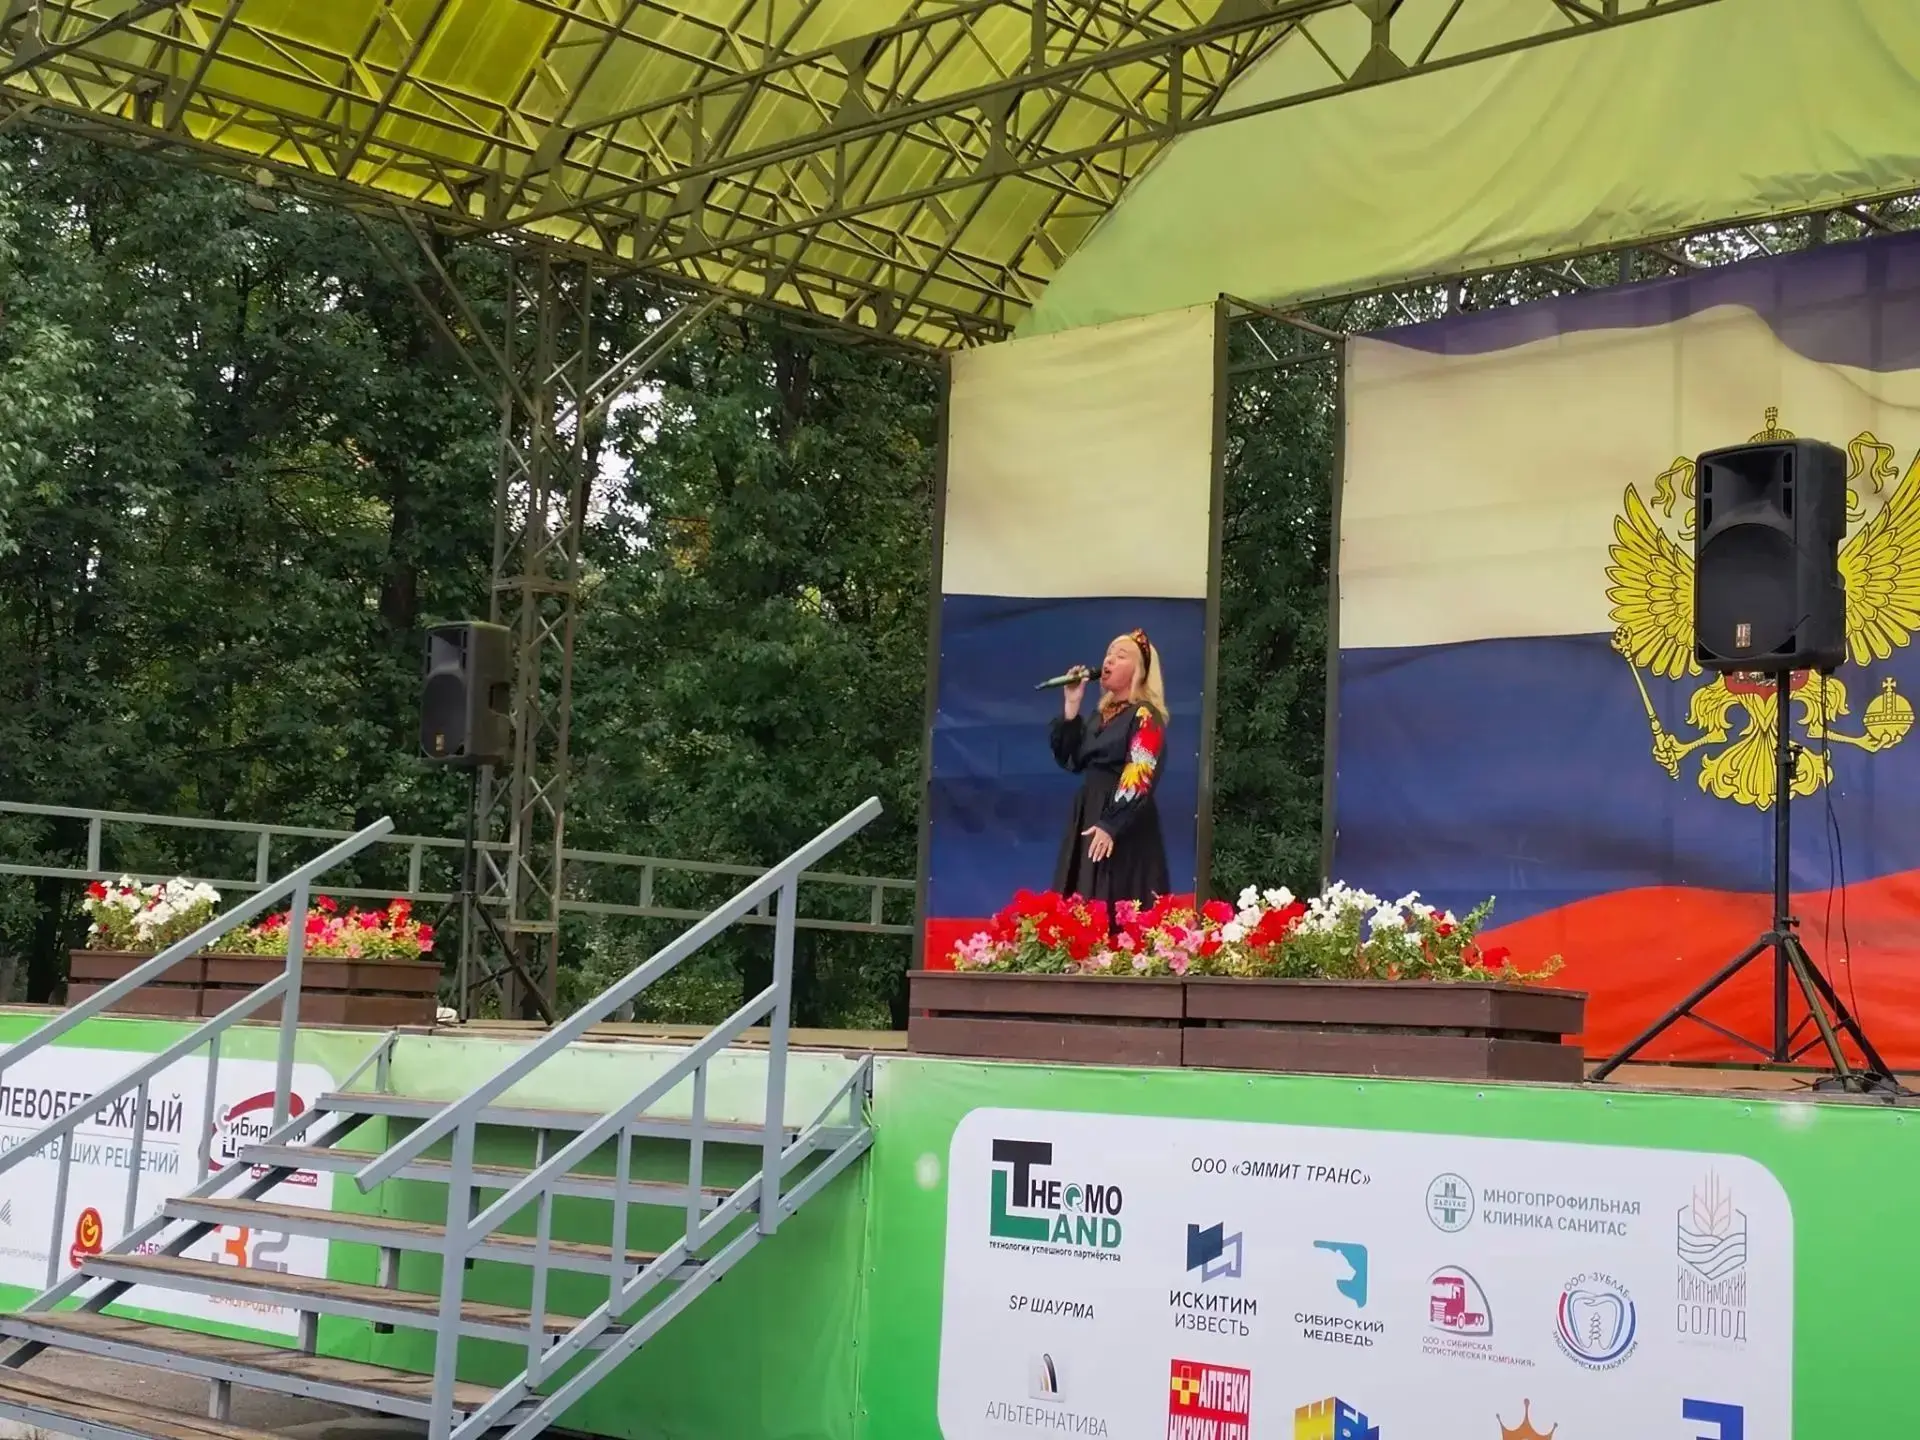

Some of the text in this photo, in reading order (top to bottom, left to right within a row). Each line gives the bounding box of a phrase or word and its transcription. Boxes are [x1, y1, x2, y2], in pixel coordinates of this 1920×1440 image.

[1191, 1156, 1372, 1186] ООО «ЭММИТ ТРАНС»
[1483, 1188, 1641, 1216] МНОГОПРОФИЛЬНАЯ
[1483, 1209, 1554, 1230] КЛИНИКА
[1557, 1215, 1628, 1237] САНИТАС
[989, 1240, 1031, 1252] технологии
[1031, 1245, 1073, 1257] успешного
[1009, 1294, 1095, 1320] SP ШАУРМА
[1169, 1289, 1257, 1316] ИСКИТИМ
[1175, 1312, 1250, 1337] ИЗВЕСТЬ
[1294, 1311, 1385, 1334] СИБИРСКИЙ
[1677, 1303, 1747, 1343] СОЛОД
[1303, 1328, 1374, 1348] МЕДВЕДЬ
[1198, 1367, 1249, 1415] АПТЕКИ
[985, 1400, 1108, 1438] АЛЬТЕРНАТИВА
